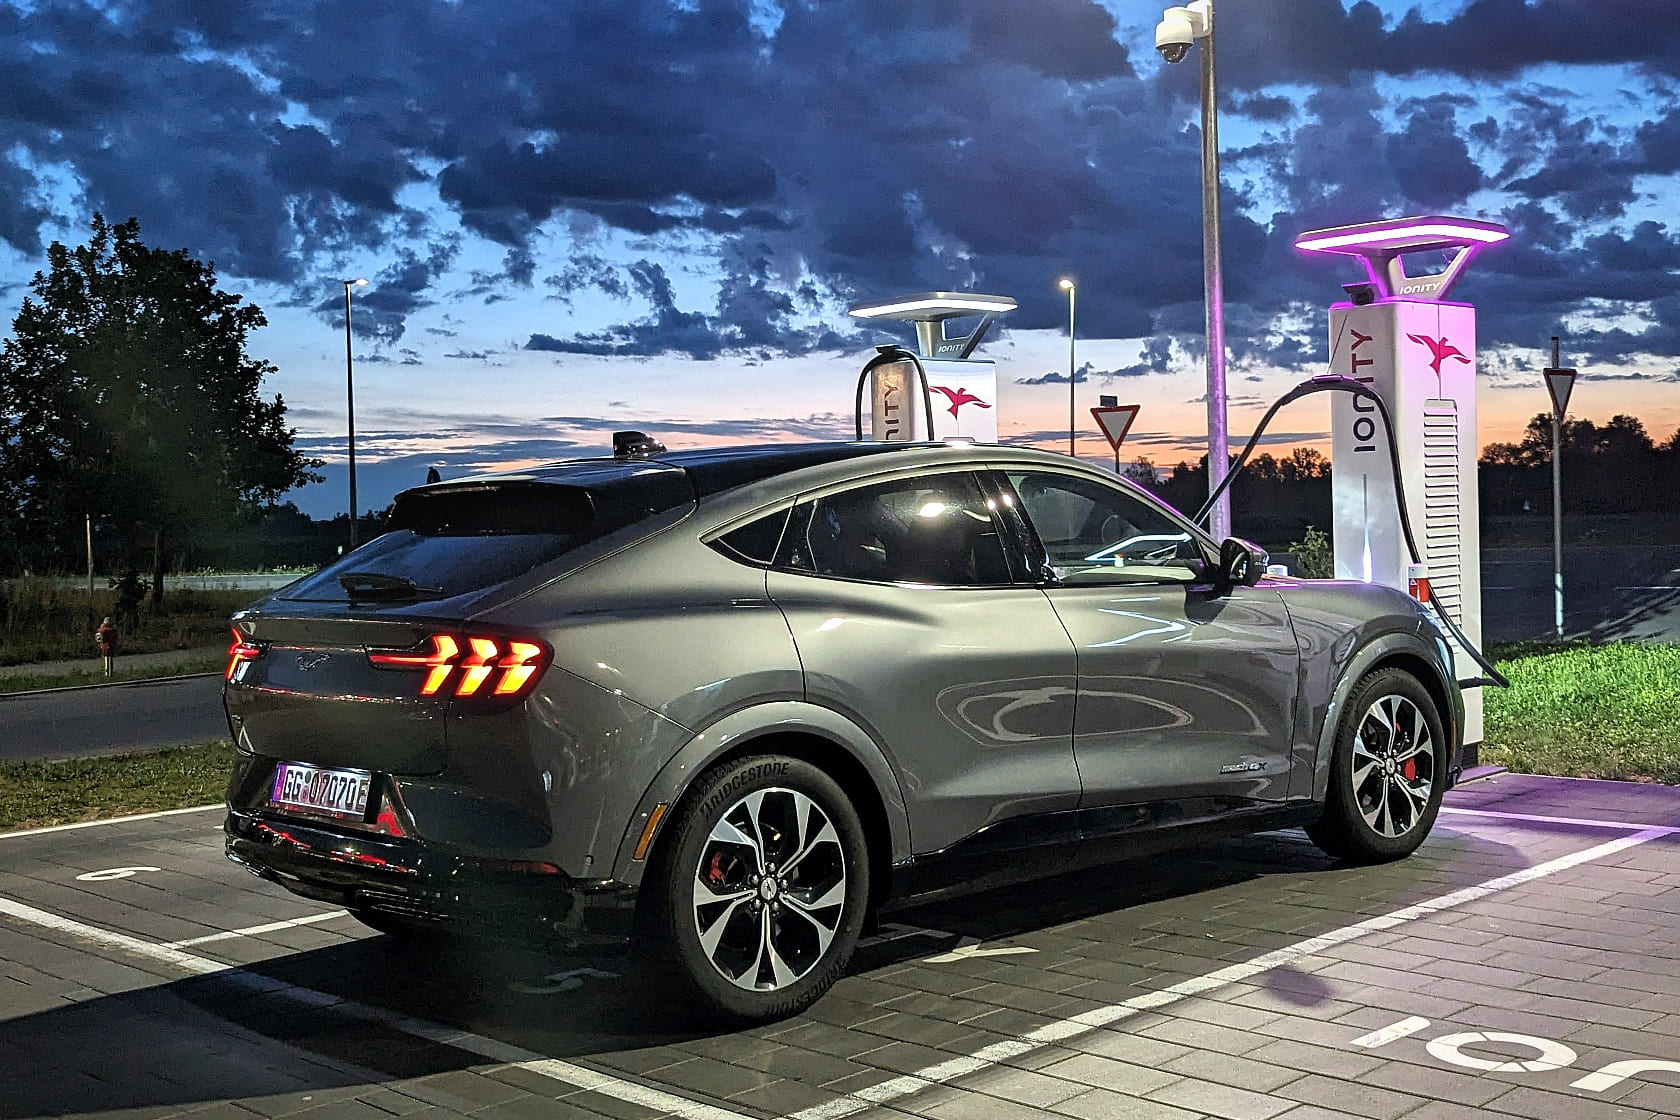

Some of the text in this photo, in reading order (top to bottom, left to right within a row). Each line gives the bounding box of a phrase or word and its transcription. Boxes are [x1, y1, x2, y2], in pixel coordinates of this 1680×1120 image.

[1399, 282, 1441, 295] IONITY
[938, 343, 965, 353] IONITY
[283, 769, 303, 801] GG
